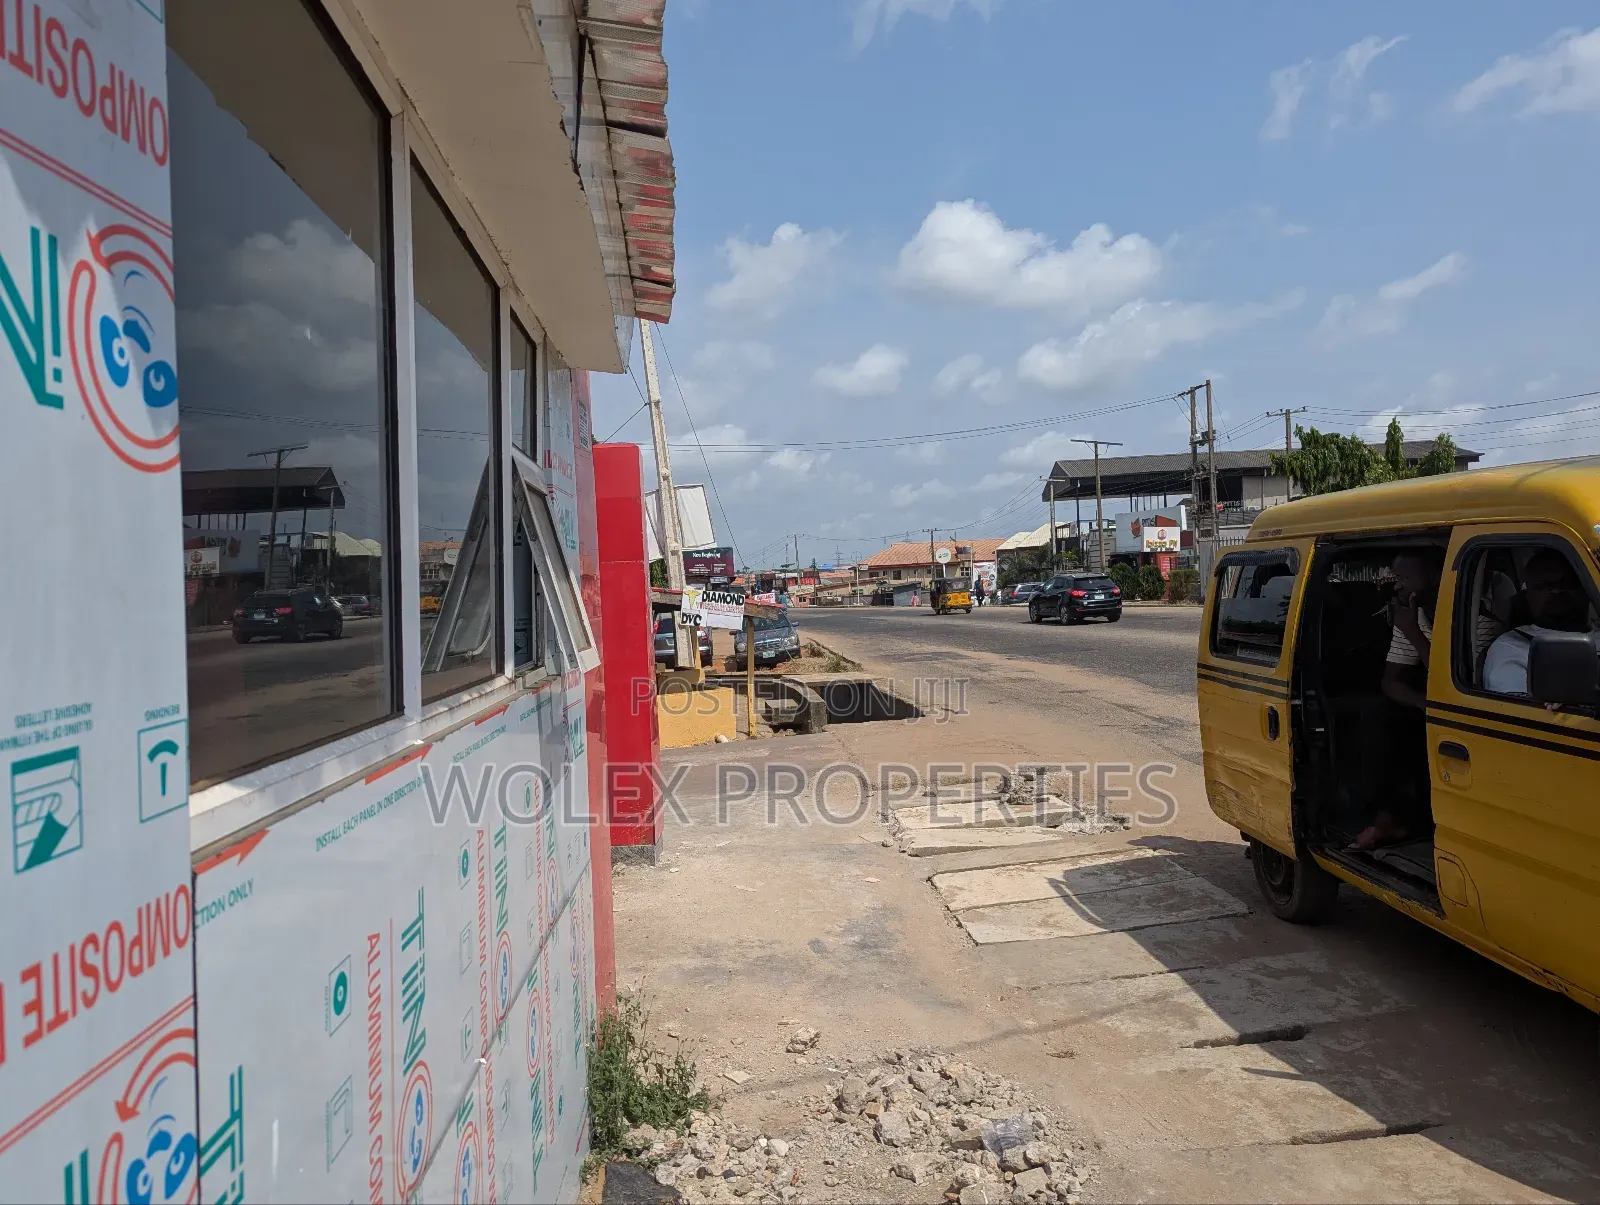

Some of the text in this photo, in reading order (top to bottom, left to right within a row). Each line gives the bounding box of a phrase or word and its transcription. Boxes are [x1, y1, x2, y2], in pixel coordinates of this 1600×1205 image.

[0, 0, 168, 167] OMPOSIT
[702, 590, 744, 606] DIAMOND
[14, 709, 52, 728] LETTERS
[144, 704, 181, 721] BENDING
[316, 825, 342, 852] INSTALL
[343, 814, 359, 834] EACH
[359, 804, 376, 824] PANEL
[377, 799, 383, 814] IN
[383, 792, 394, 809] ONE
[394, 780, 416, 802] DIRECTION
[196, 878, 254, 930] TION ONLY
[477, 829, 487, 967] ALUMINIUM
[367, 932, 382, 1135] ALUMINIUM
